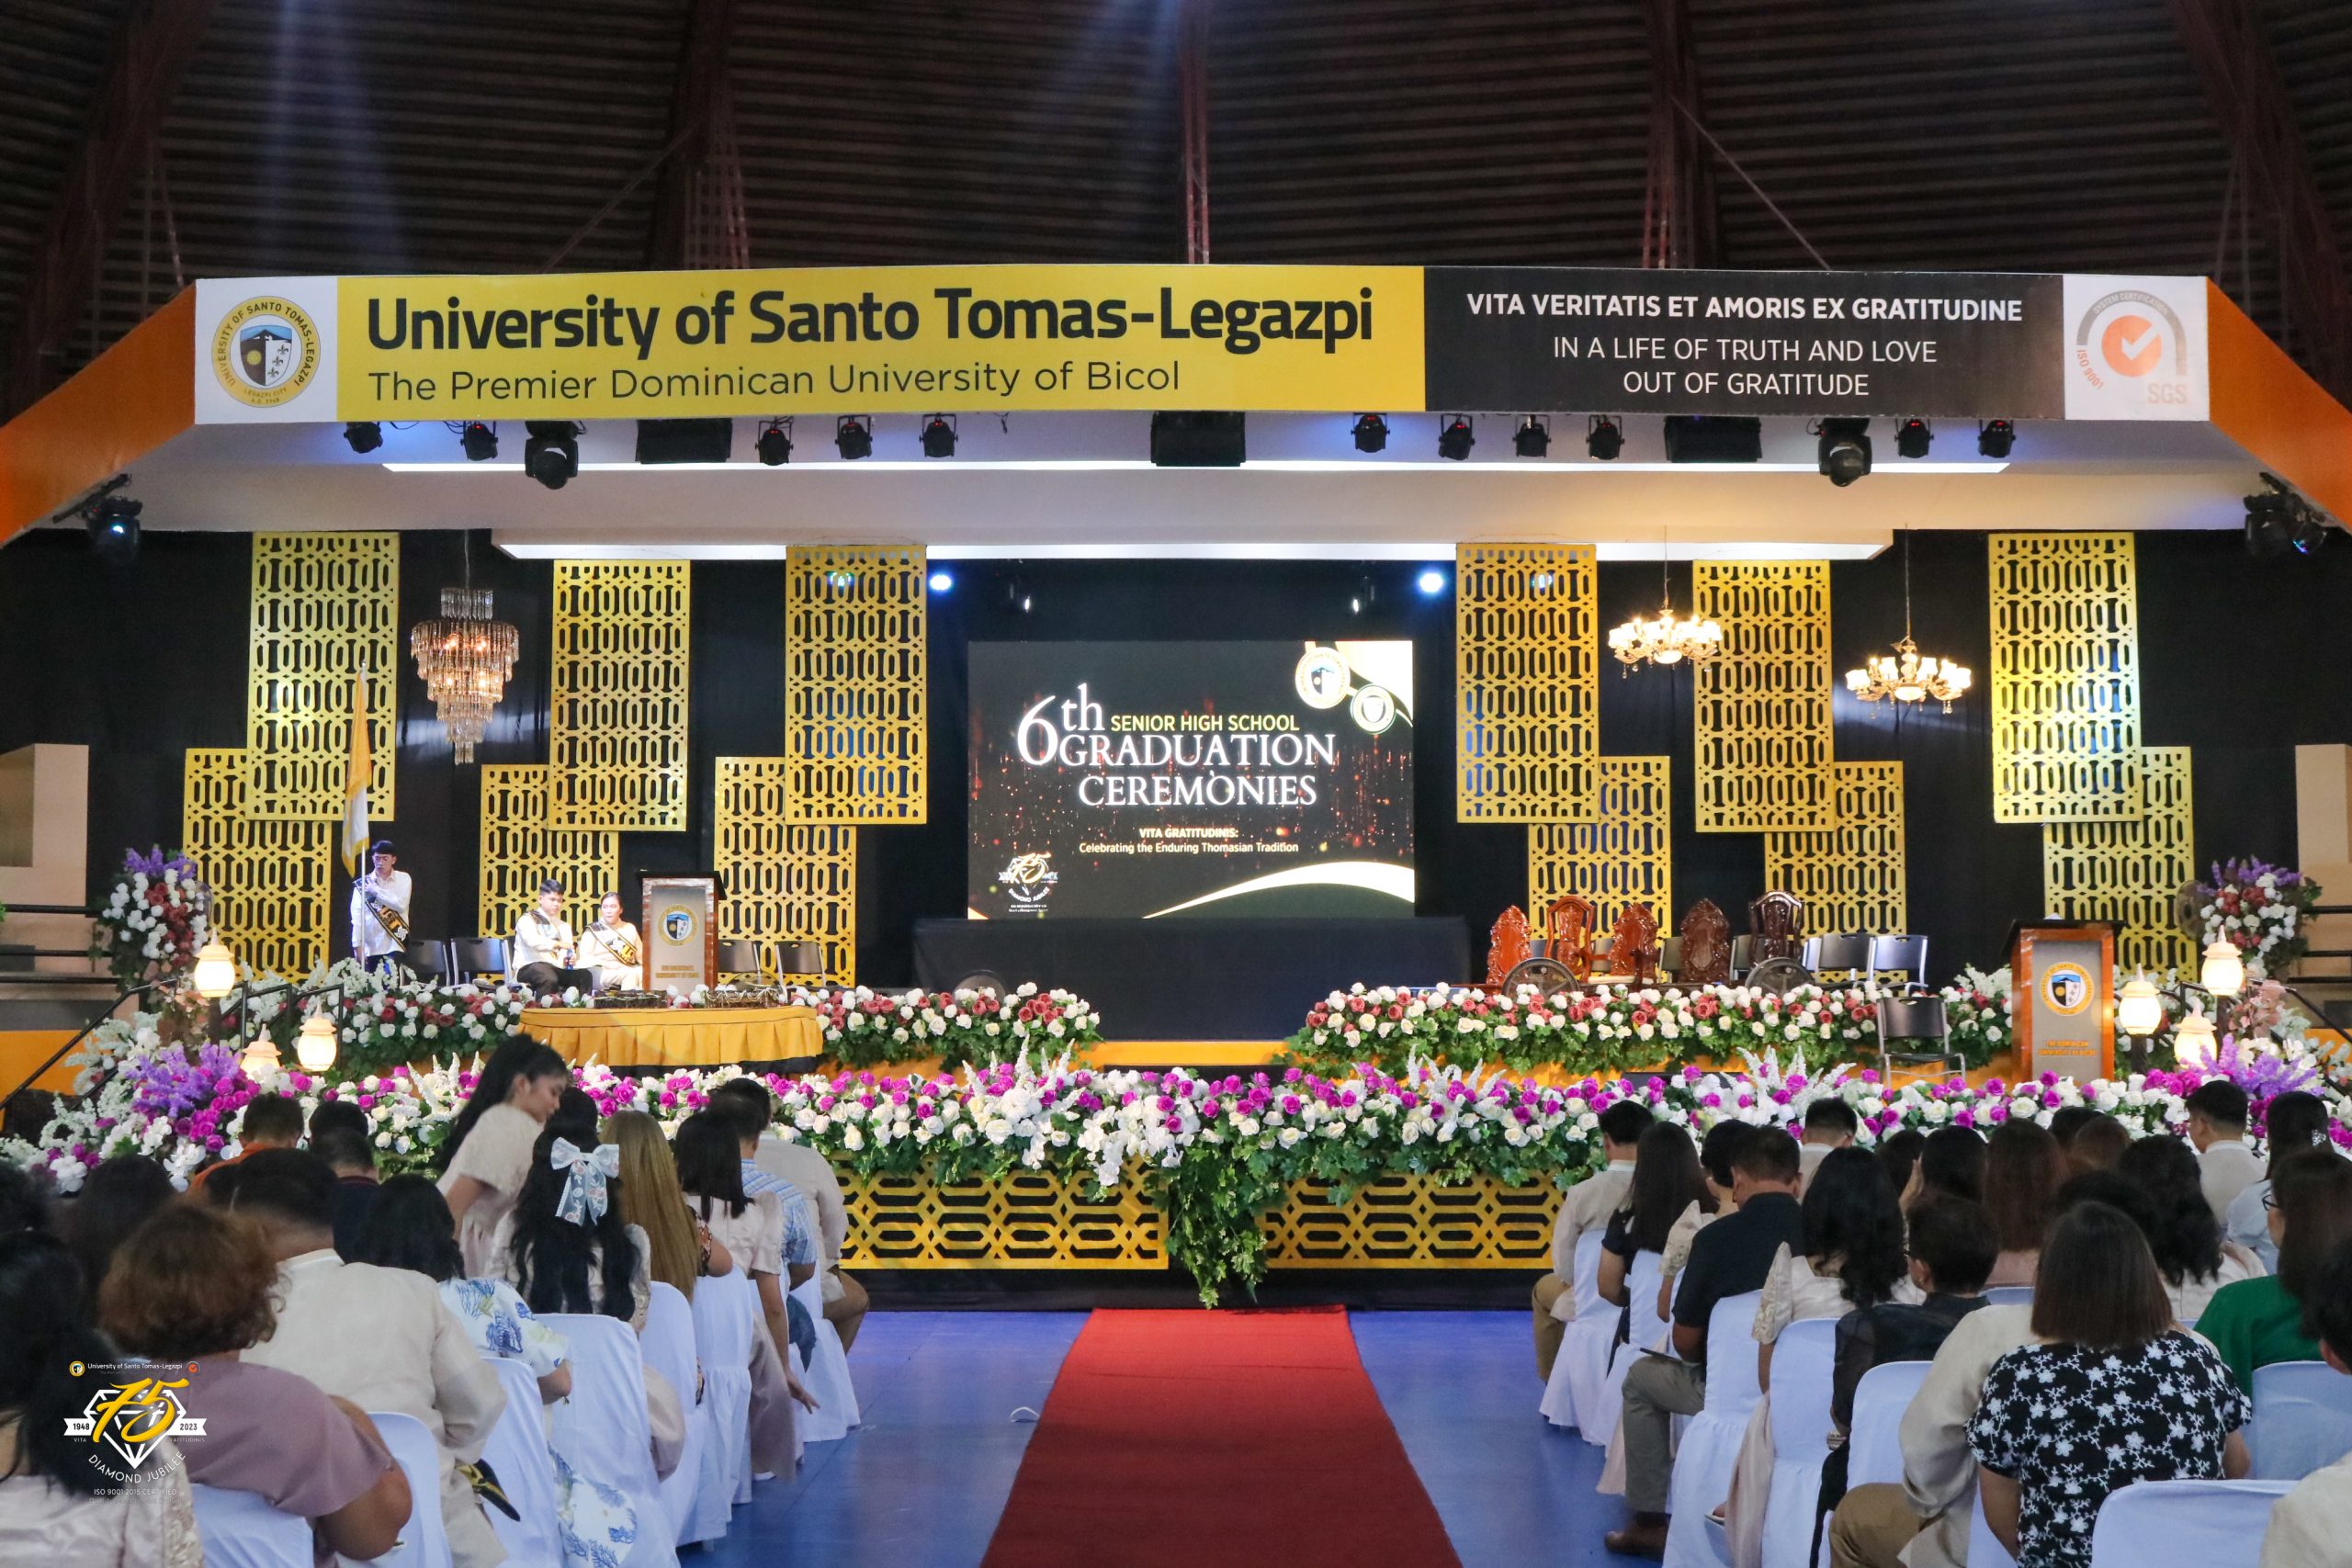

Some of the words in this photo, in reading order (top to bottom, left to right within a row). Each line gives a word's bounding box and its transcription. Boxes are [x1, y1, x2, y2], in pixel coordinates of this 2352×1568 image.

[1467, 294, 1525, 315] VITA
[1532, 295, 1660, 316] VERITATIS
[1668, 297, 1698, 317] ET
[1705, 297, 1805, 319] AMORIS
[1814, 299, 1845, 319] EX
[1852, 299, 2022, 321] GRATITUDINE
[2093, 294, 2119, 314] SYSTEM
[369, 294, 660, 360] University
[676, 290, 734, 344] of
[750, 291, 919, 343] Santo
[934, 288, 1372, 355] Tomas-Legazpi
[218, 323, 236, 387] UNIVERSITY
[232, 310, 243, 323] OF
[246, 301, 282, 314] SANTO
[285, 306, 315, 387] TOMAS-LEGAZPI
[1555, 337, 1578, 357] IN
[1588, 337, 1606, 358] A
[1614, 338, 1666, 359] LIFE
[1675, 338, 1708, 359] OF
[1716, 339, 1799, 361] TRUTH
[1808, 340, 1863, 361] AND
[1872, 341, 1937, 362] LOVE
[368, 372, 435, 400] The
[452, 370, 596, 400] Premier
[613, 367, 812, 398] Dominican
[831, 362, 1020, 396] University
[1035, 361, 1073, 390] of
[1089, 361, 1179, 389] Bicol
[1623, 371, 1676, 392] OUT
[1685, 372, 1718, 393] OF
[1727, 373, 1869, 395] GRATITUDE
[2076, 349, 2089, 367] ISO
[2084, 367, 2104, 389] 9001
[2148, 383, 2187, 404] SGS
[1016, 682, 1106, 766] 6th
[1111, 715, 1175, 731] SENIOR
[1181, 715, 1223, 731] HIGH
[1228, 715, 1299, 731] SCHOOL
[1059, 733, 1336, 766] GRADUATION
[1079, 775, 1317, 806] CEREMONIES
[1079, 842, 1135, 854] Celebrating
[1137, 842, 1153, 852] the
[1155, 842, 1199, 854] Enduring
[1203, 842, 1253, 852] Thomasian
[1257, 842, 1298, 852] Tradition
[1139, 828, 1162, 838] VITA
[1164, 828, 1238, 838] GRATITUDINIS:
[1011, 852, 1051, 884] 75
